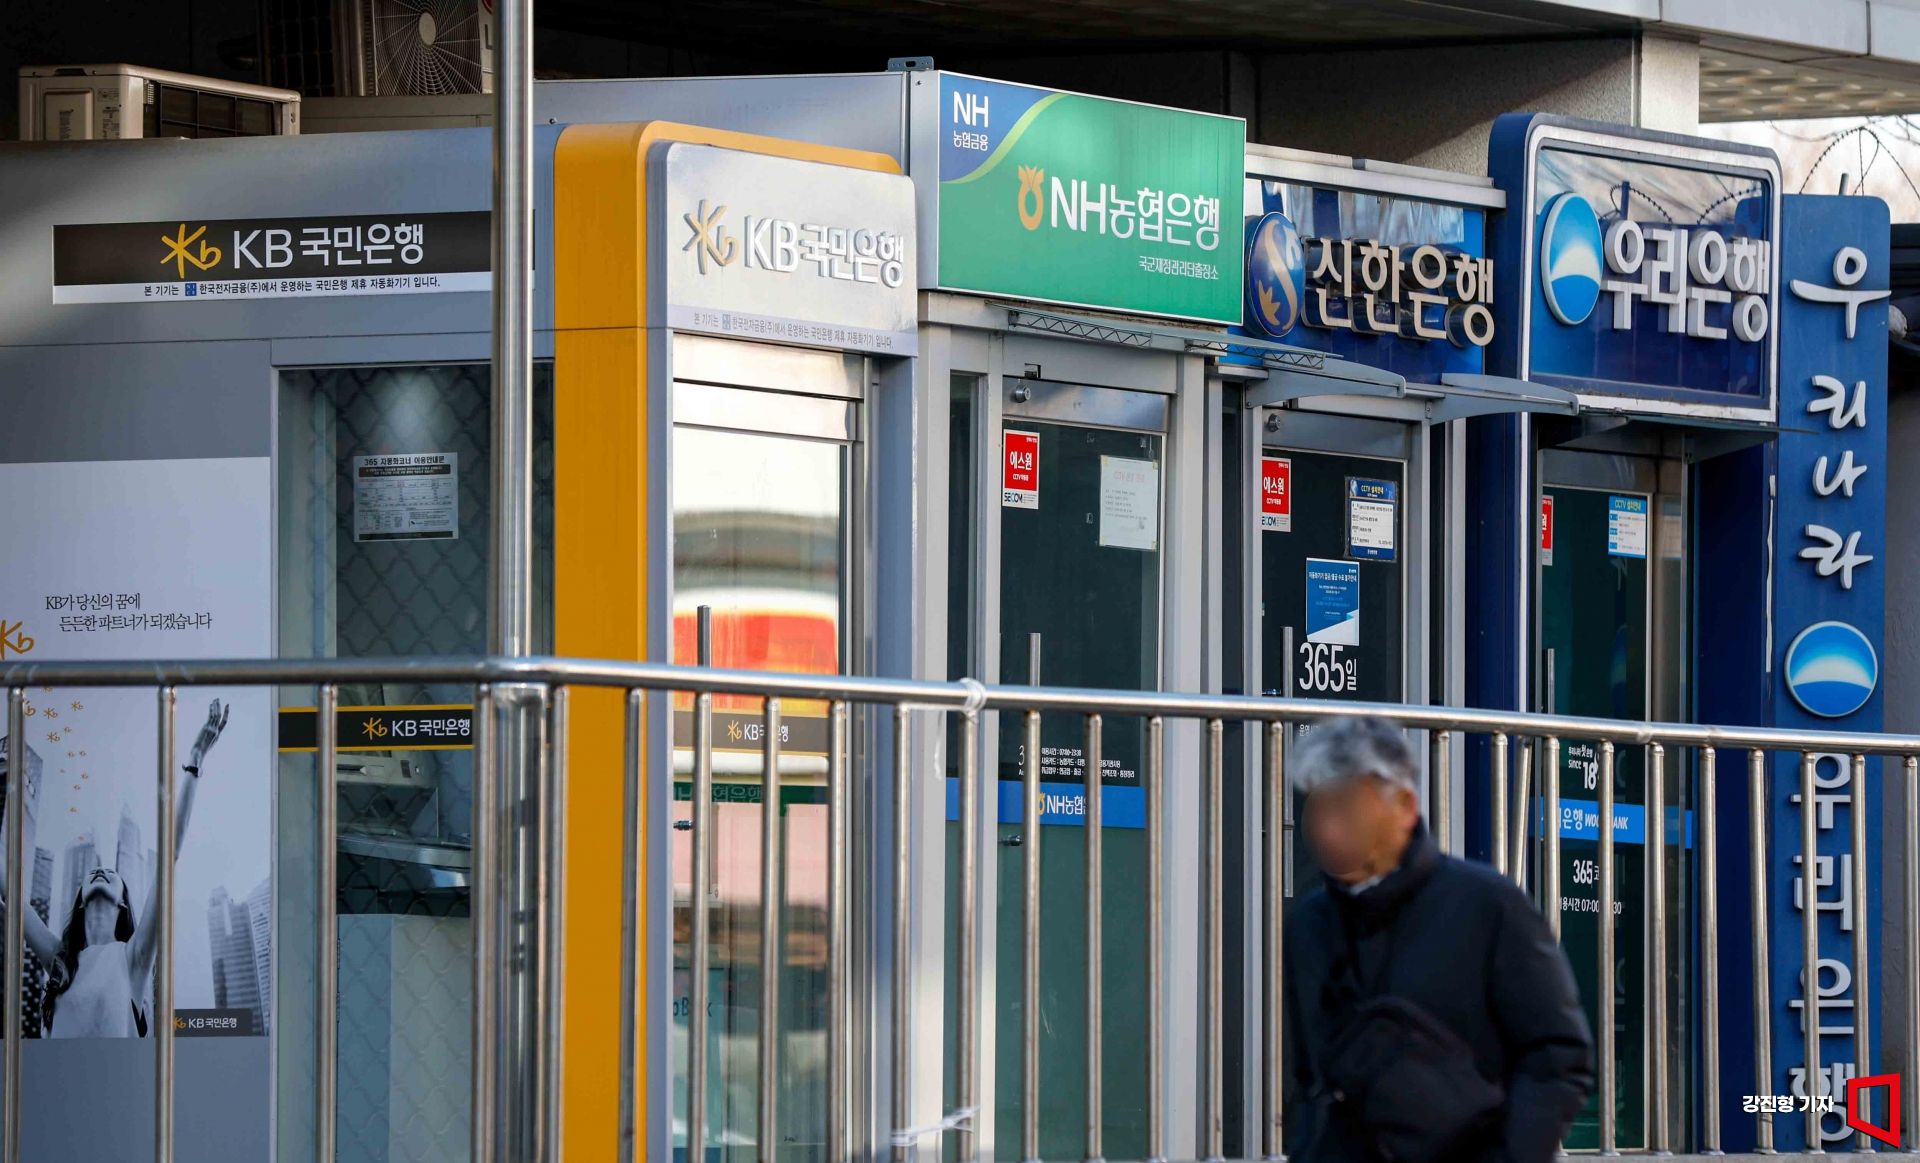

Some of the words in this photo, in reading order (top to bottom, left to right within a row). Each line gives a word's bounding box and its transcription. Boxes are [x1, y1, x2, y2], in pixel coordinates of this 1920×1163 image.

[953, 90, 989, 128] NH
[953, 130, 989, 152] 농협금융
[1051, 175, 1220, 251] NH농협은행
[1138, 255, 1219, 280] 국군재정관리단출장소
[143, 285, 152, 297] 본
[155, 285, 180, 297] 기기는
[199, 283, 278, 296] 한국전자금융(주)에서
[280, 281, 313, 293] 운영하는
[316, 279, 348, 292] 국민은행
[351, 278, 367, 290] 제휴
[370, 277, 411, 289] 자동화기기
[413, 276, 441, 288] 입니다.
[1304, 236, 1495, 347] 신한은행
[1600, 219, 1769, 343] 우리은행
[702, 313, 719, 328] 기기는
[787, 323, 810, 338] 운영하는
[811, 326, 833, 343] 국민은행
[834, 329, 846, 343] 제휴
[847, 332, 875, 347] 자동화기기
[876, 335, 894, 349] 입니다.
[1789, 246, 1892, 590] 우리나라
[364, 458, 378, 466] 365
[1009, 450, 1033, 471] 에스원
[1263, 476, 1285, 495] 에스원
[1004, 492, 1023, 504] SECOM
[1261, 515, 1277, 527] ECOM
[46, 594, 75, 611] KB가
[76, 593, 113, 611] 당신의
[115, 593, 141, 610] 꿈에
[59, 615, 98, 632] 든든한
[99, 614, 149, 632] 파트너가
[150, 612, 212, 631] 되겠습니다
[1046, 794, 1086, 815] NH농협
